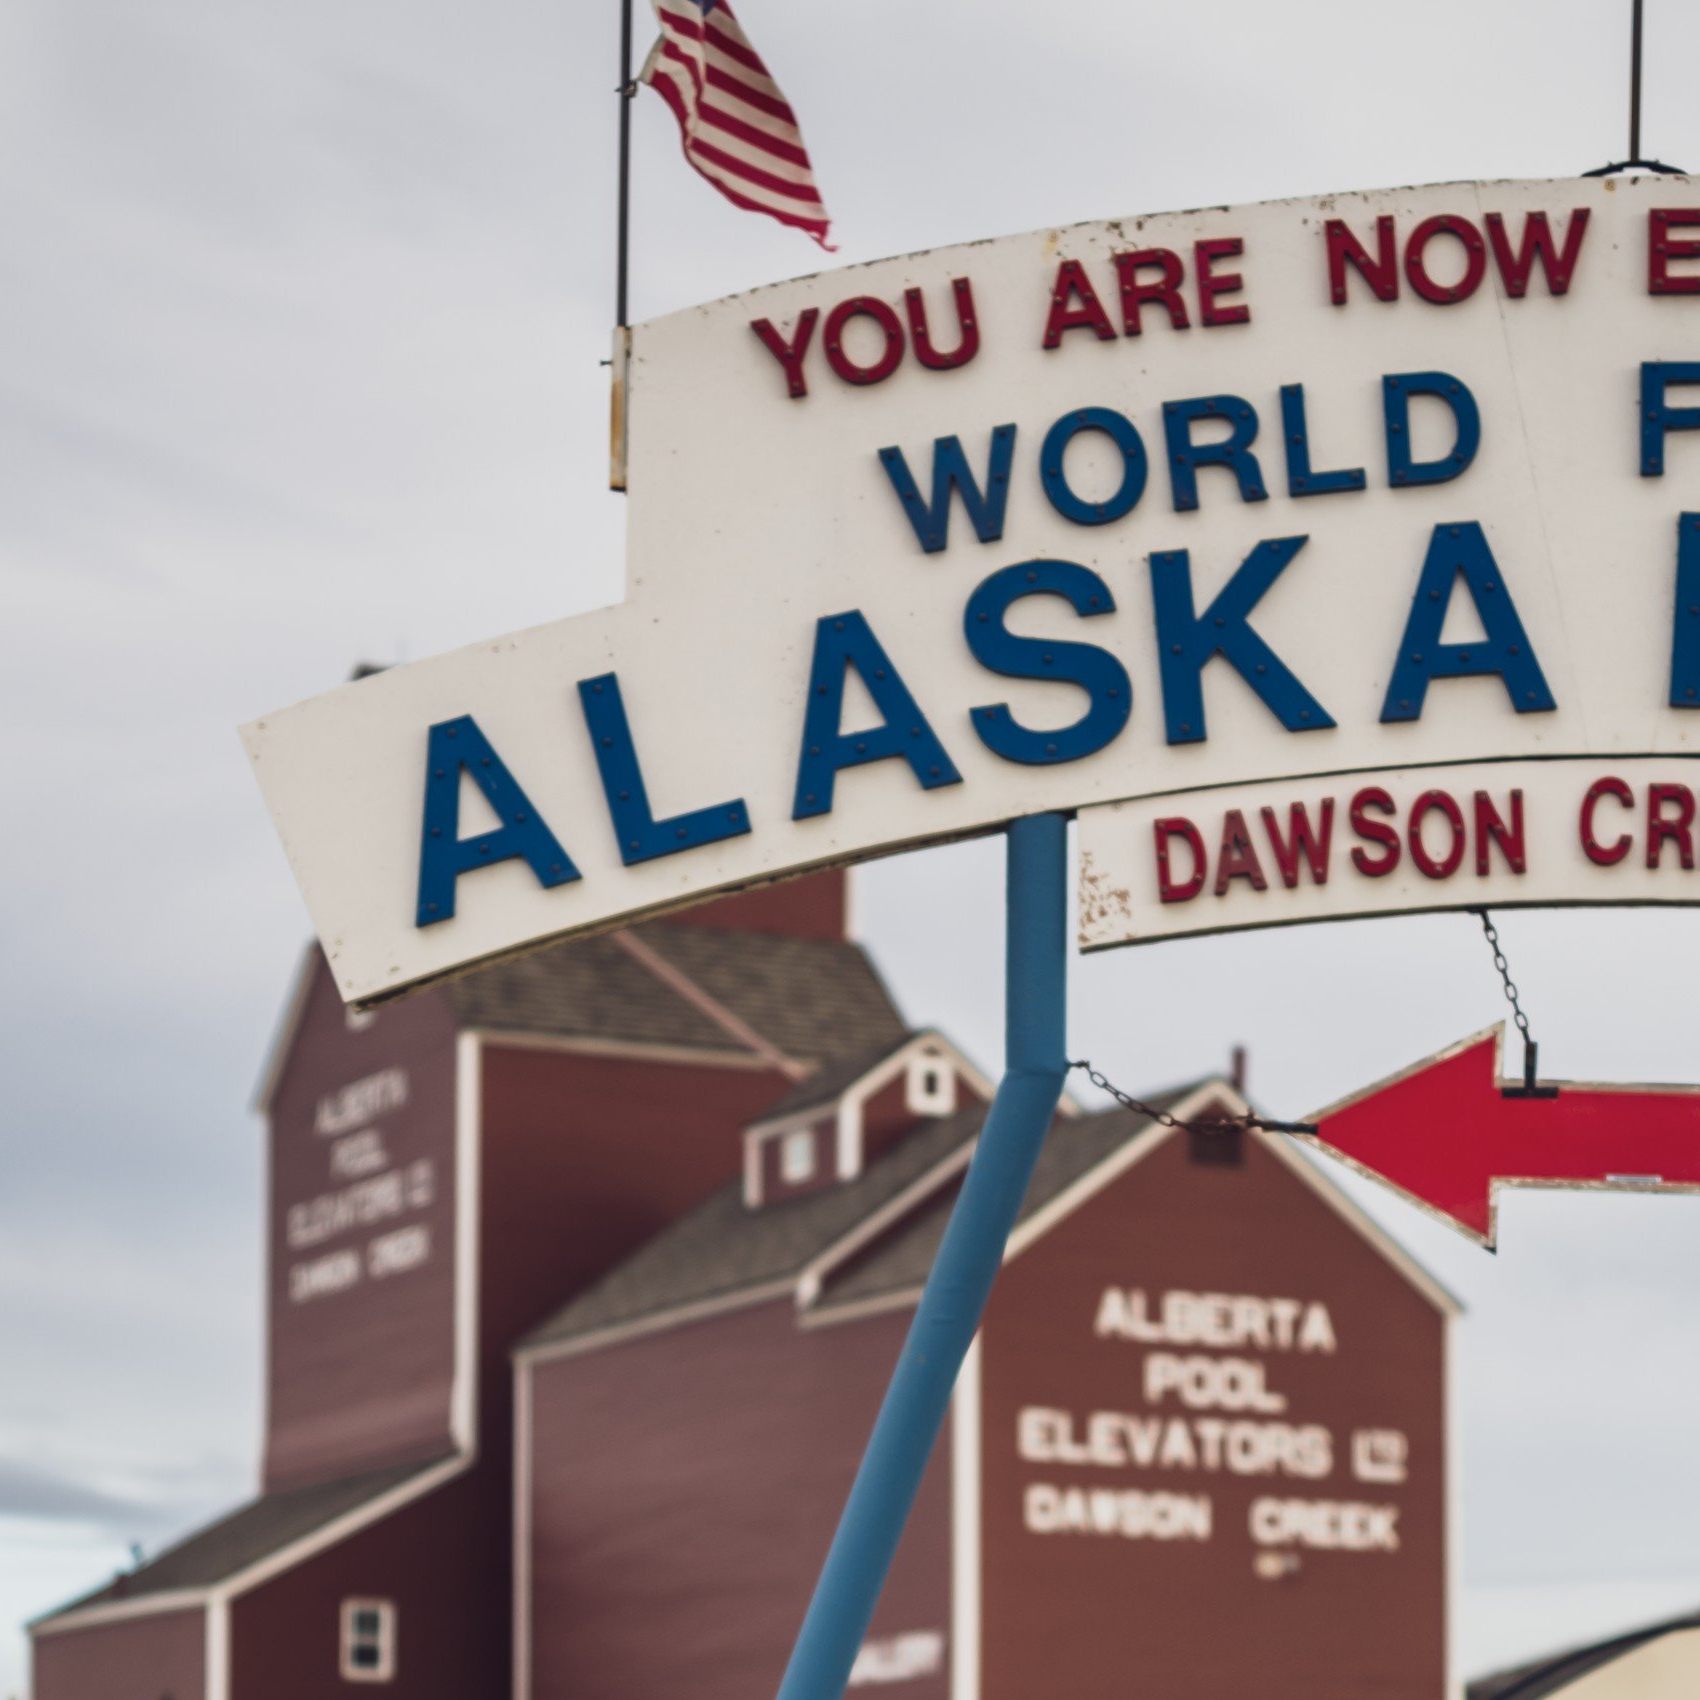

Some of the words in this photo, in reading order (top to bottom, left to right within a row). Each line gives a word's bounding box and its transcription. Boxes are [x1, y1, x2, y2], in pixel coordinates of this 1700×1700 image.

[752, 278, 979, 399] YOU
[1044, 238, 1249, 348] ARE
[1325, 208, 1590, 305] NOW
[878, 372, 1481, 553] WORLD
[416, 520, 1556, 928] ALASKA
[1154, 789, 1526, 903] DAWSON
[1095, 1287, 1337, 1354] ALBERTA
[1143, 1353, 1289, 1414] POOL
[1017, 1406, 1334, 1479] ELEVATORS
[1023, 1484, 1211, 1542] DAWSON
[1249, 1497, 1400, 1551] CREEK
